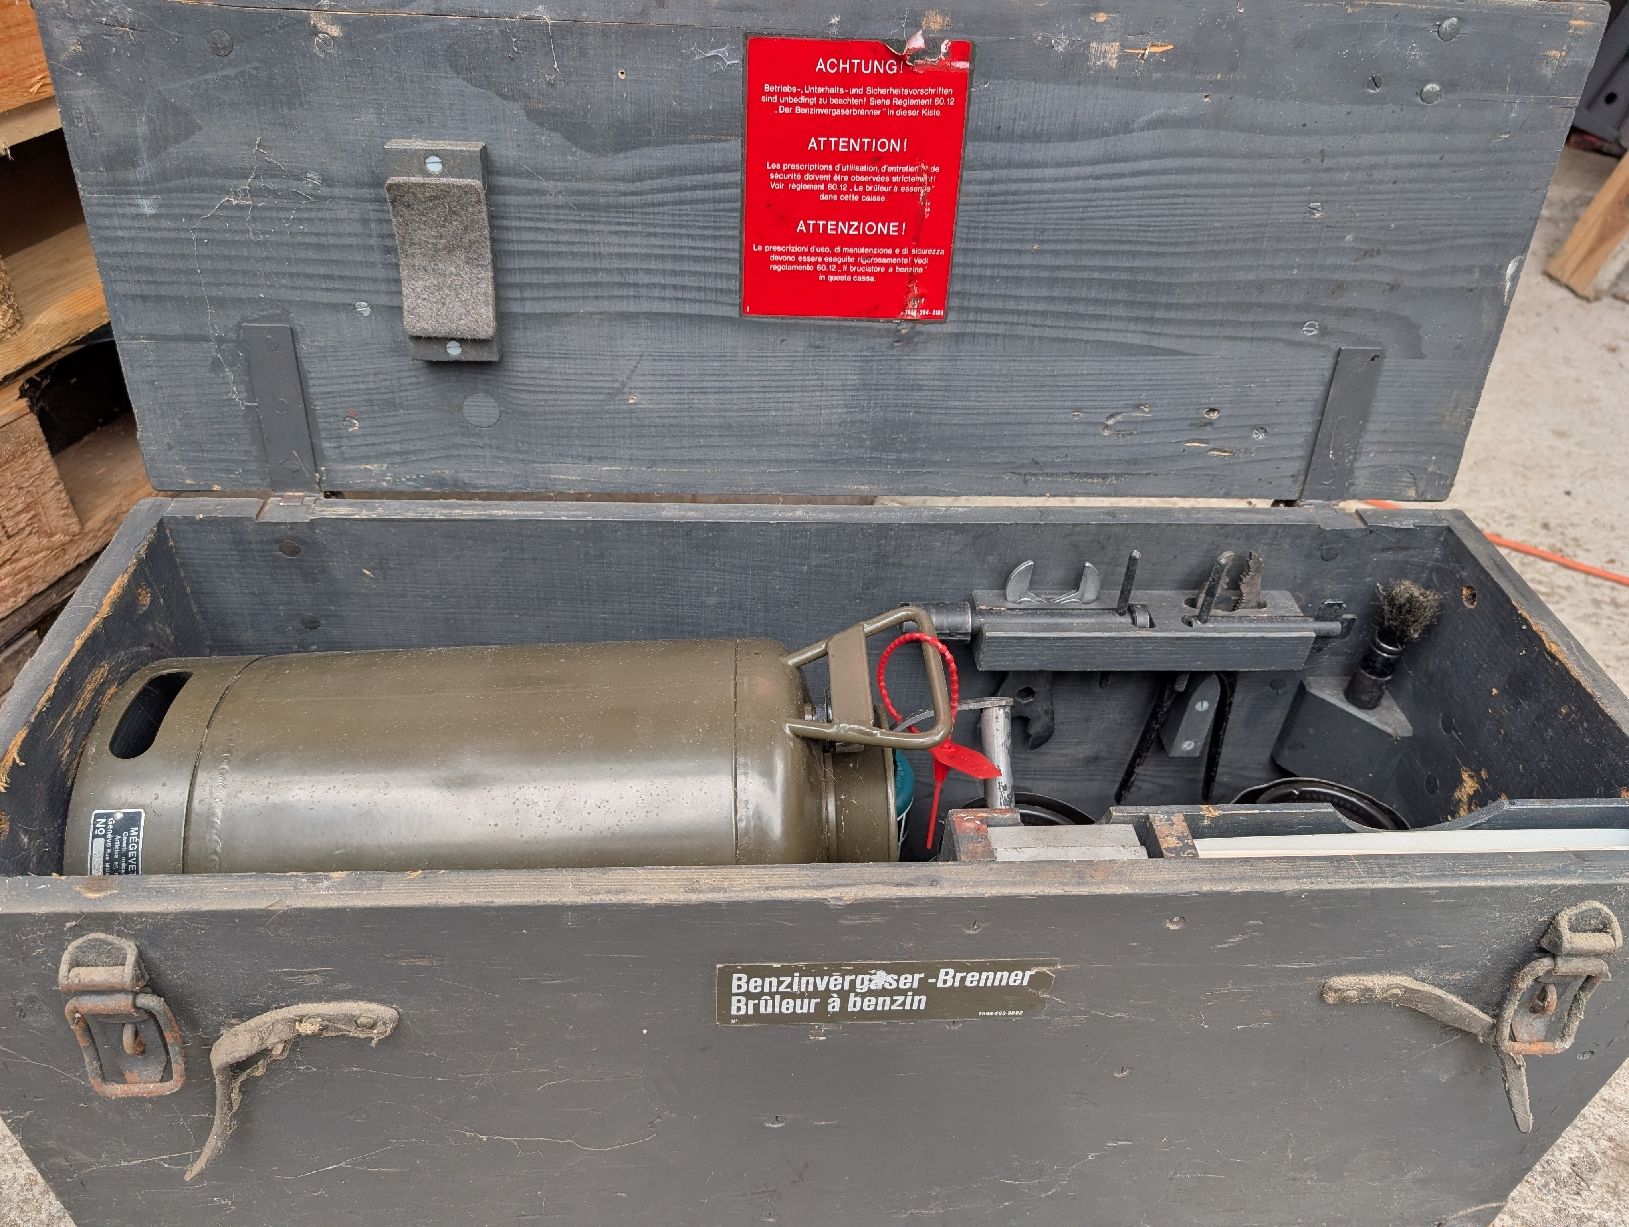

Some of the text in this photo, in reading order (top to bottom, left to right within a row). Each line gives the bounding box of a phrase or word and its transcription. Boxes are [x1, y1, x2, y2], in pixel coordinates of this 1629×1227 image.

[815, 58, 903, 74] ACHTUNG!
[849, 86, 863, 94] und
[865, 86, 953, 96] Sicherheitsvorschriften
[761, 95, 777, 103] sind
[780, 96, 816, 105] unbedingt
[829, 96, 867, 105] beachten!
[892, 98, 932, 107] Reglement
[807, 137, 908, 152] ATTENTION!
[766, 162, 781, 170] Les
[782, 163, 832, 172] prescriptions
[803, 173, 831, 181] doivent
[833, 173, 849, 182] être
[851, 174, 890, 182] observées
[770, 182, 784, 190] Voir
[865, 183, 892, 191] brûleur
[819, 193, 837, 201] dans
[840, 193, 859, 201] cette
[796, 220, 906, 236] ATTENZIONE!
[764, 245, 808, 253] prescrizioni
[834, 246, 841, 254] di
[842, 247, 892, 255] manutenzione
[902, 247, 909, 255] di
[769, 254, 796, 262] devono
[798, 255, 822, 263] essere
[824, 255, 855, 264] eseguite
[857, 256, 911, 265] rigorosamente!
[769, 264, 814, 272] regolamento
[849, 265, 885, 273] bruciatore
[827, 275, 851, 283] questa
[730, 992, 927, 1015] Brûleur à benzin
